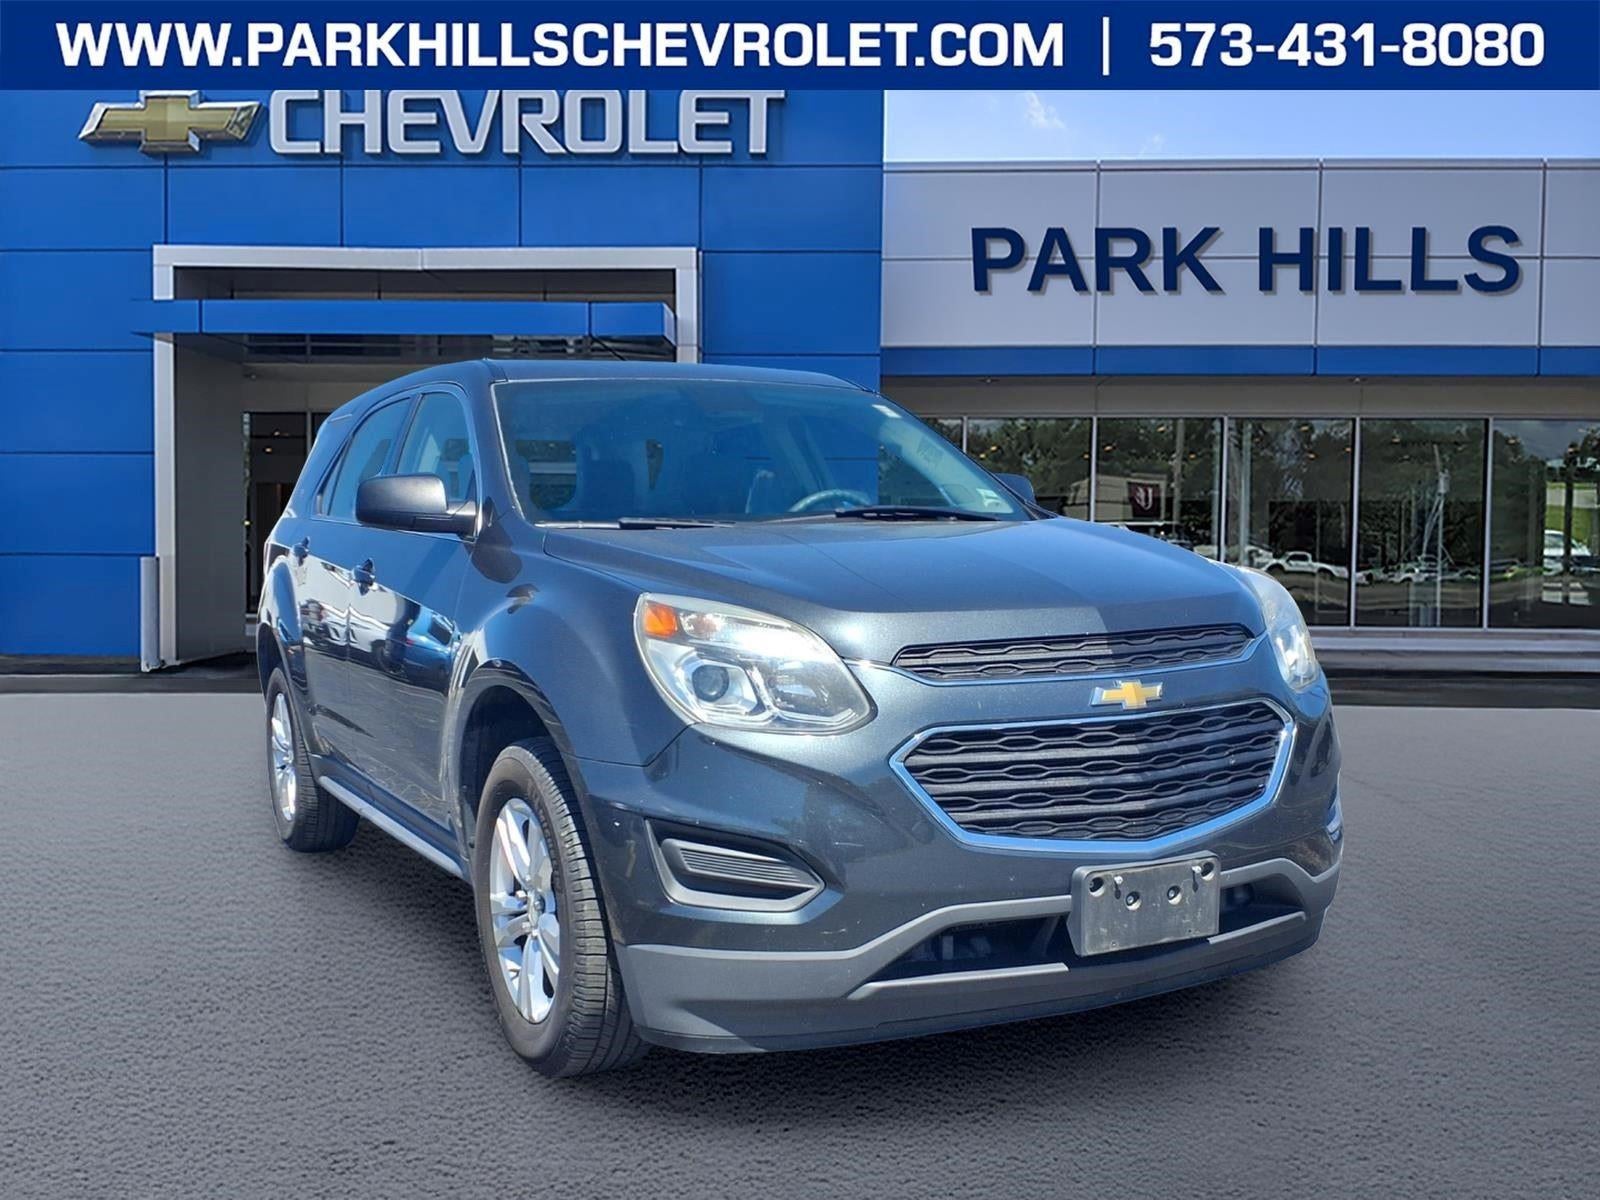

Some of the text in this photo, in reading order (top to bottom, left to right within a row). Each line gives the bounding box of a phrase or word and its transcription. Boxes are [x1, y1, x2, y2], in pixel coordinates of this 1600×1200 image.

[270, 90, 784, 155] CHEVROLET
[971, 225, 1523, 294] PARK HILLS
